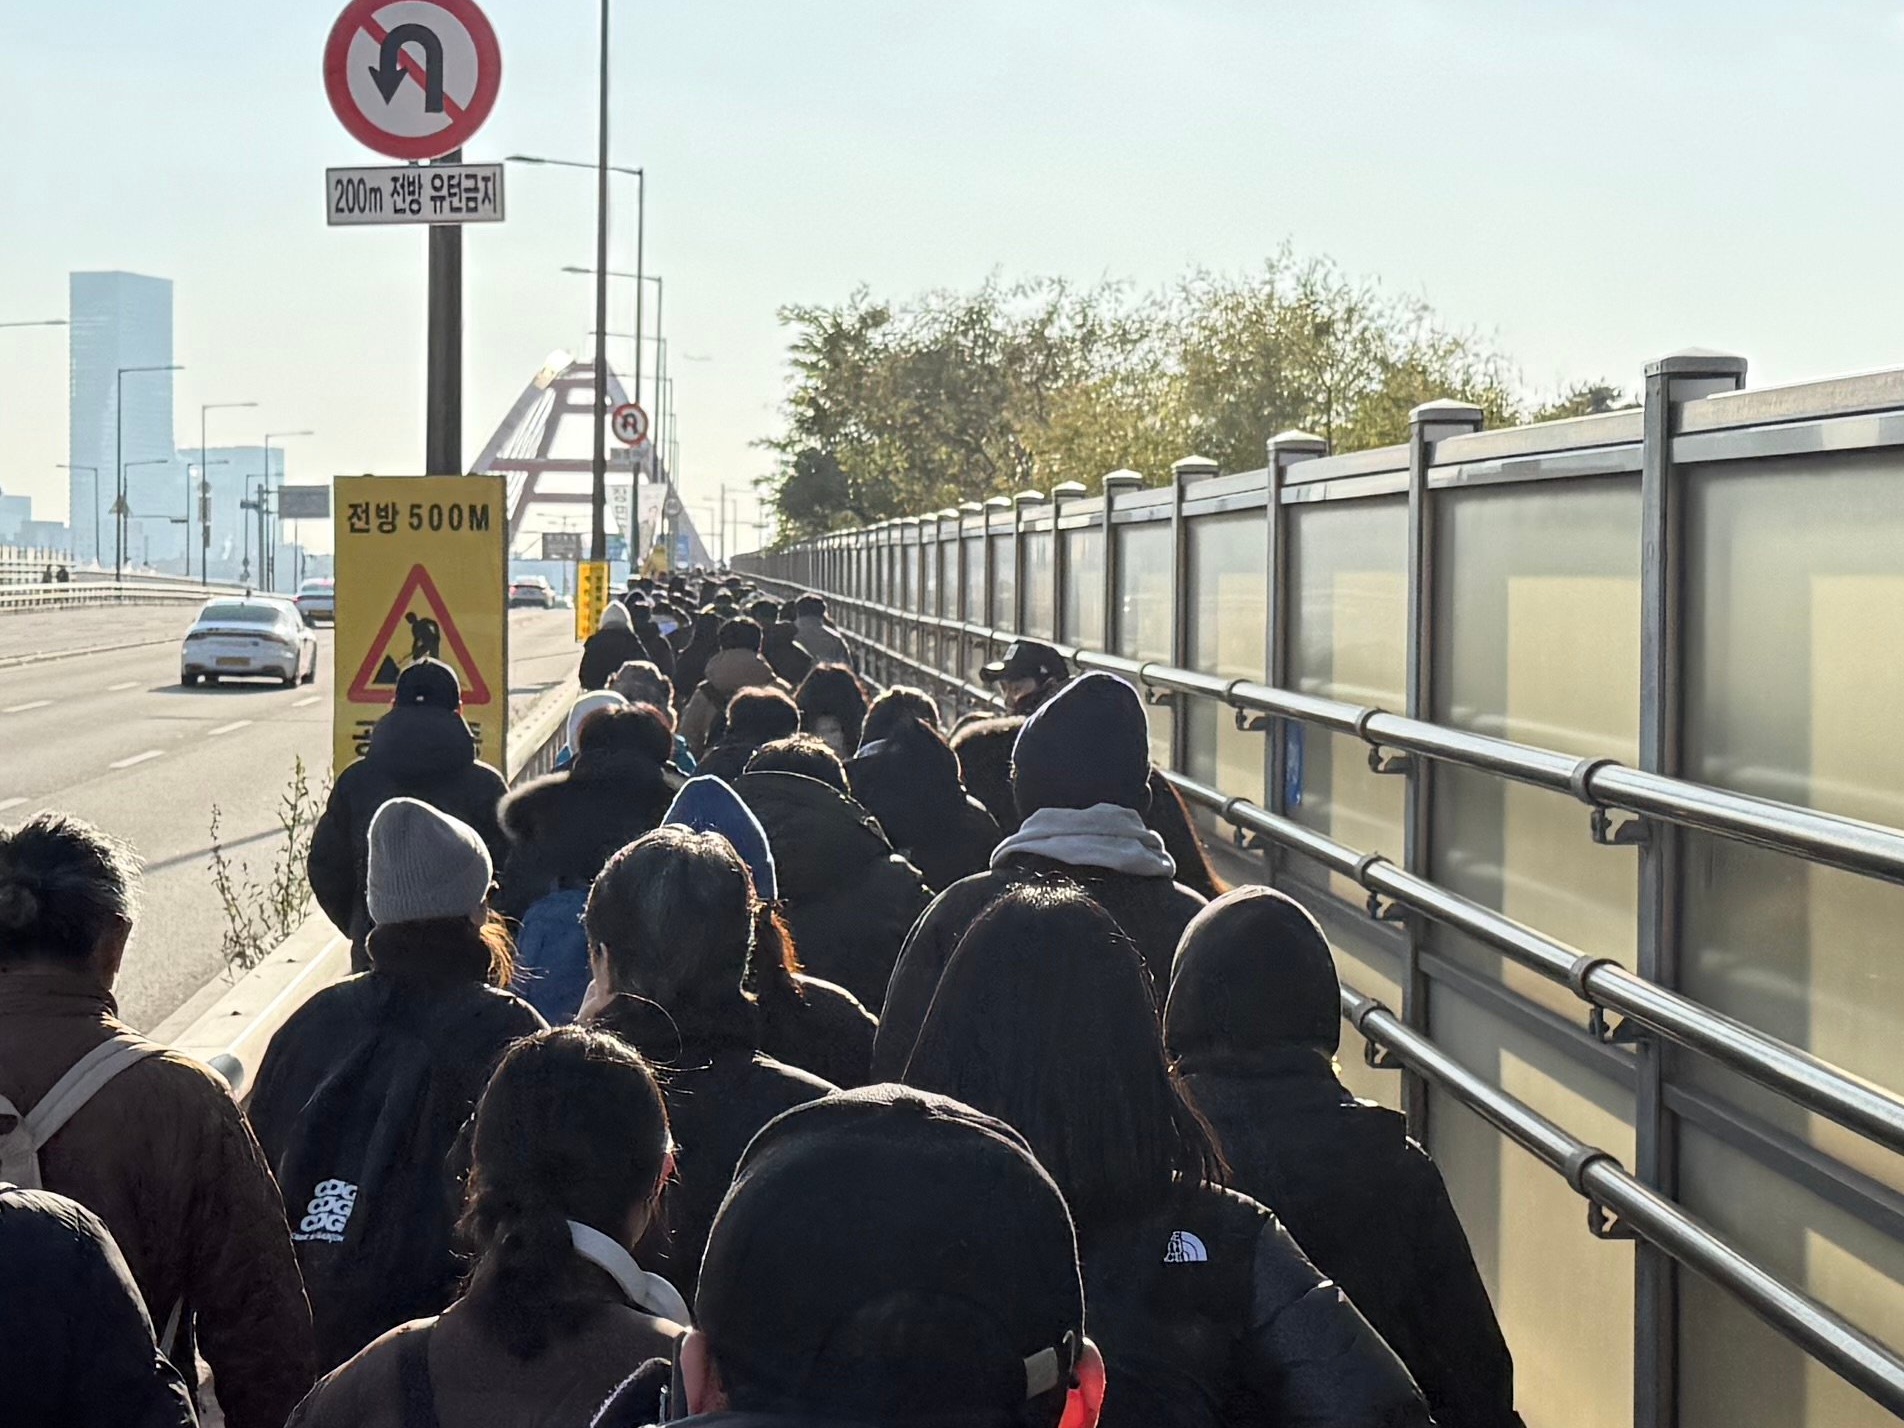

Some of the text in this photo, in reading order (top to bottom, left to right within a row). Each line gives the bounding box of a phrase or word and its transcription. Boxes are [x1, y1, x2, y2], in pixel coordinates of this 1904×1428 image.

[334, 171, 497, 216] 200m 전방 유턴금지
[347, 500, 490, 535] 전방 500M
